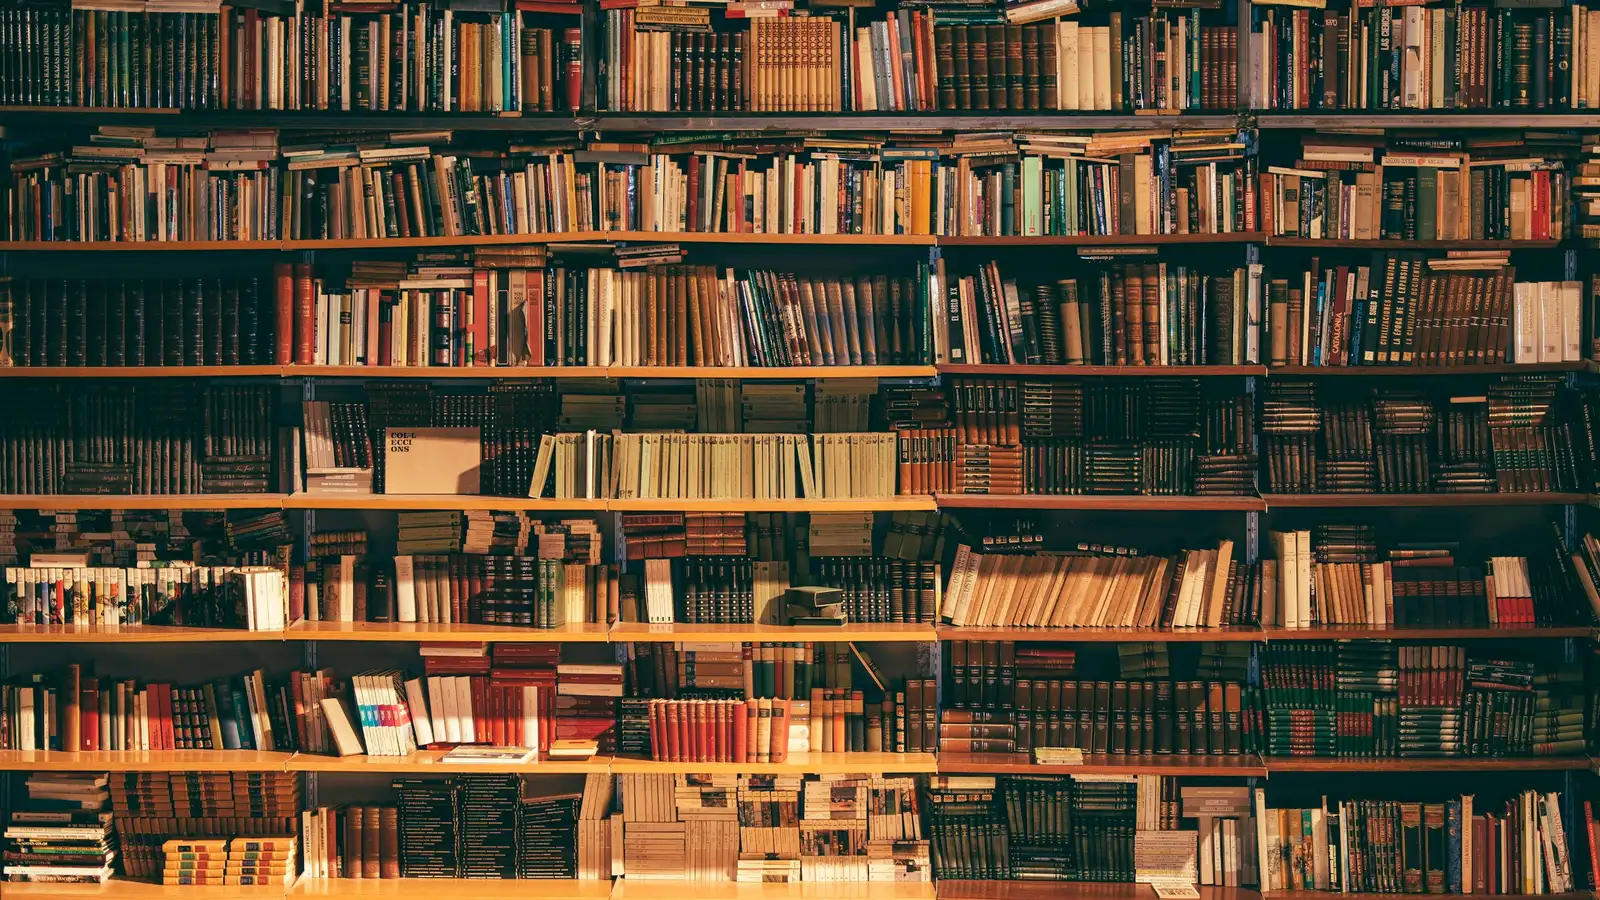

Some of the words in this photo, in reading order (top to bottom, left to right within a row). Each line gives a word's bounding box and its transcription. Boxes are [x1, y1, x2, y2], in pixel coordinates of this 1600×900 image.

[1380, 8, 1390, 37] CIENCIAS
[1380, 38, 1390, 50] LAS
[950, 287, 958, 295] XX
[1385, 258, 1396, 296] EXTINGUIDAS
[1410, 260, 1421, 296] OCCIDENTAL
[1369, 300, 1377, 315] SIGLO
[1370, 290, 1378, 298] XX
[1332, 312, 1342, 353] CATALONIA
[1380, 299, 1392, 345] CIVILIZACIONES
[963, 560, 976, 592] PARNASO
